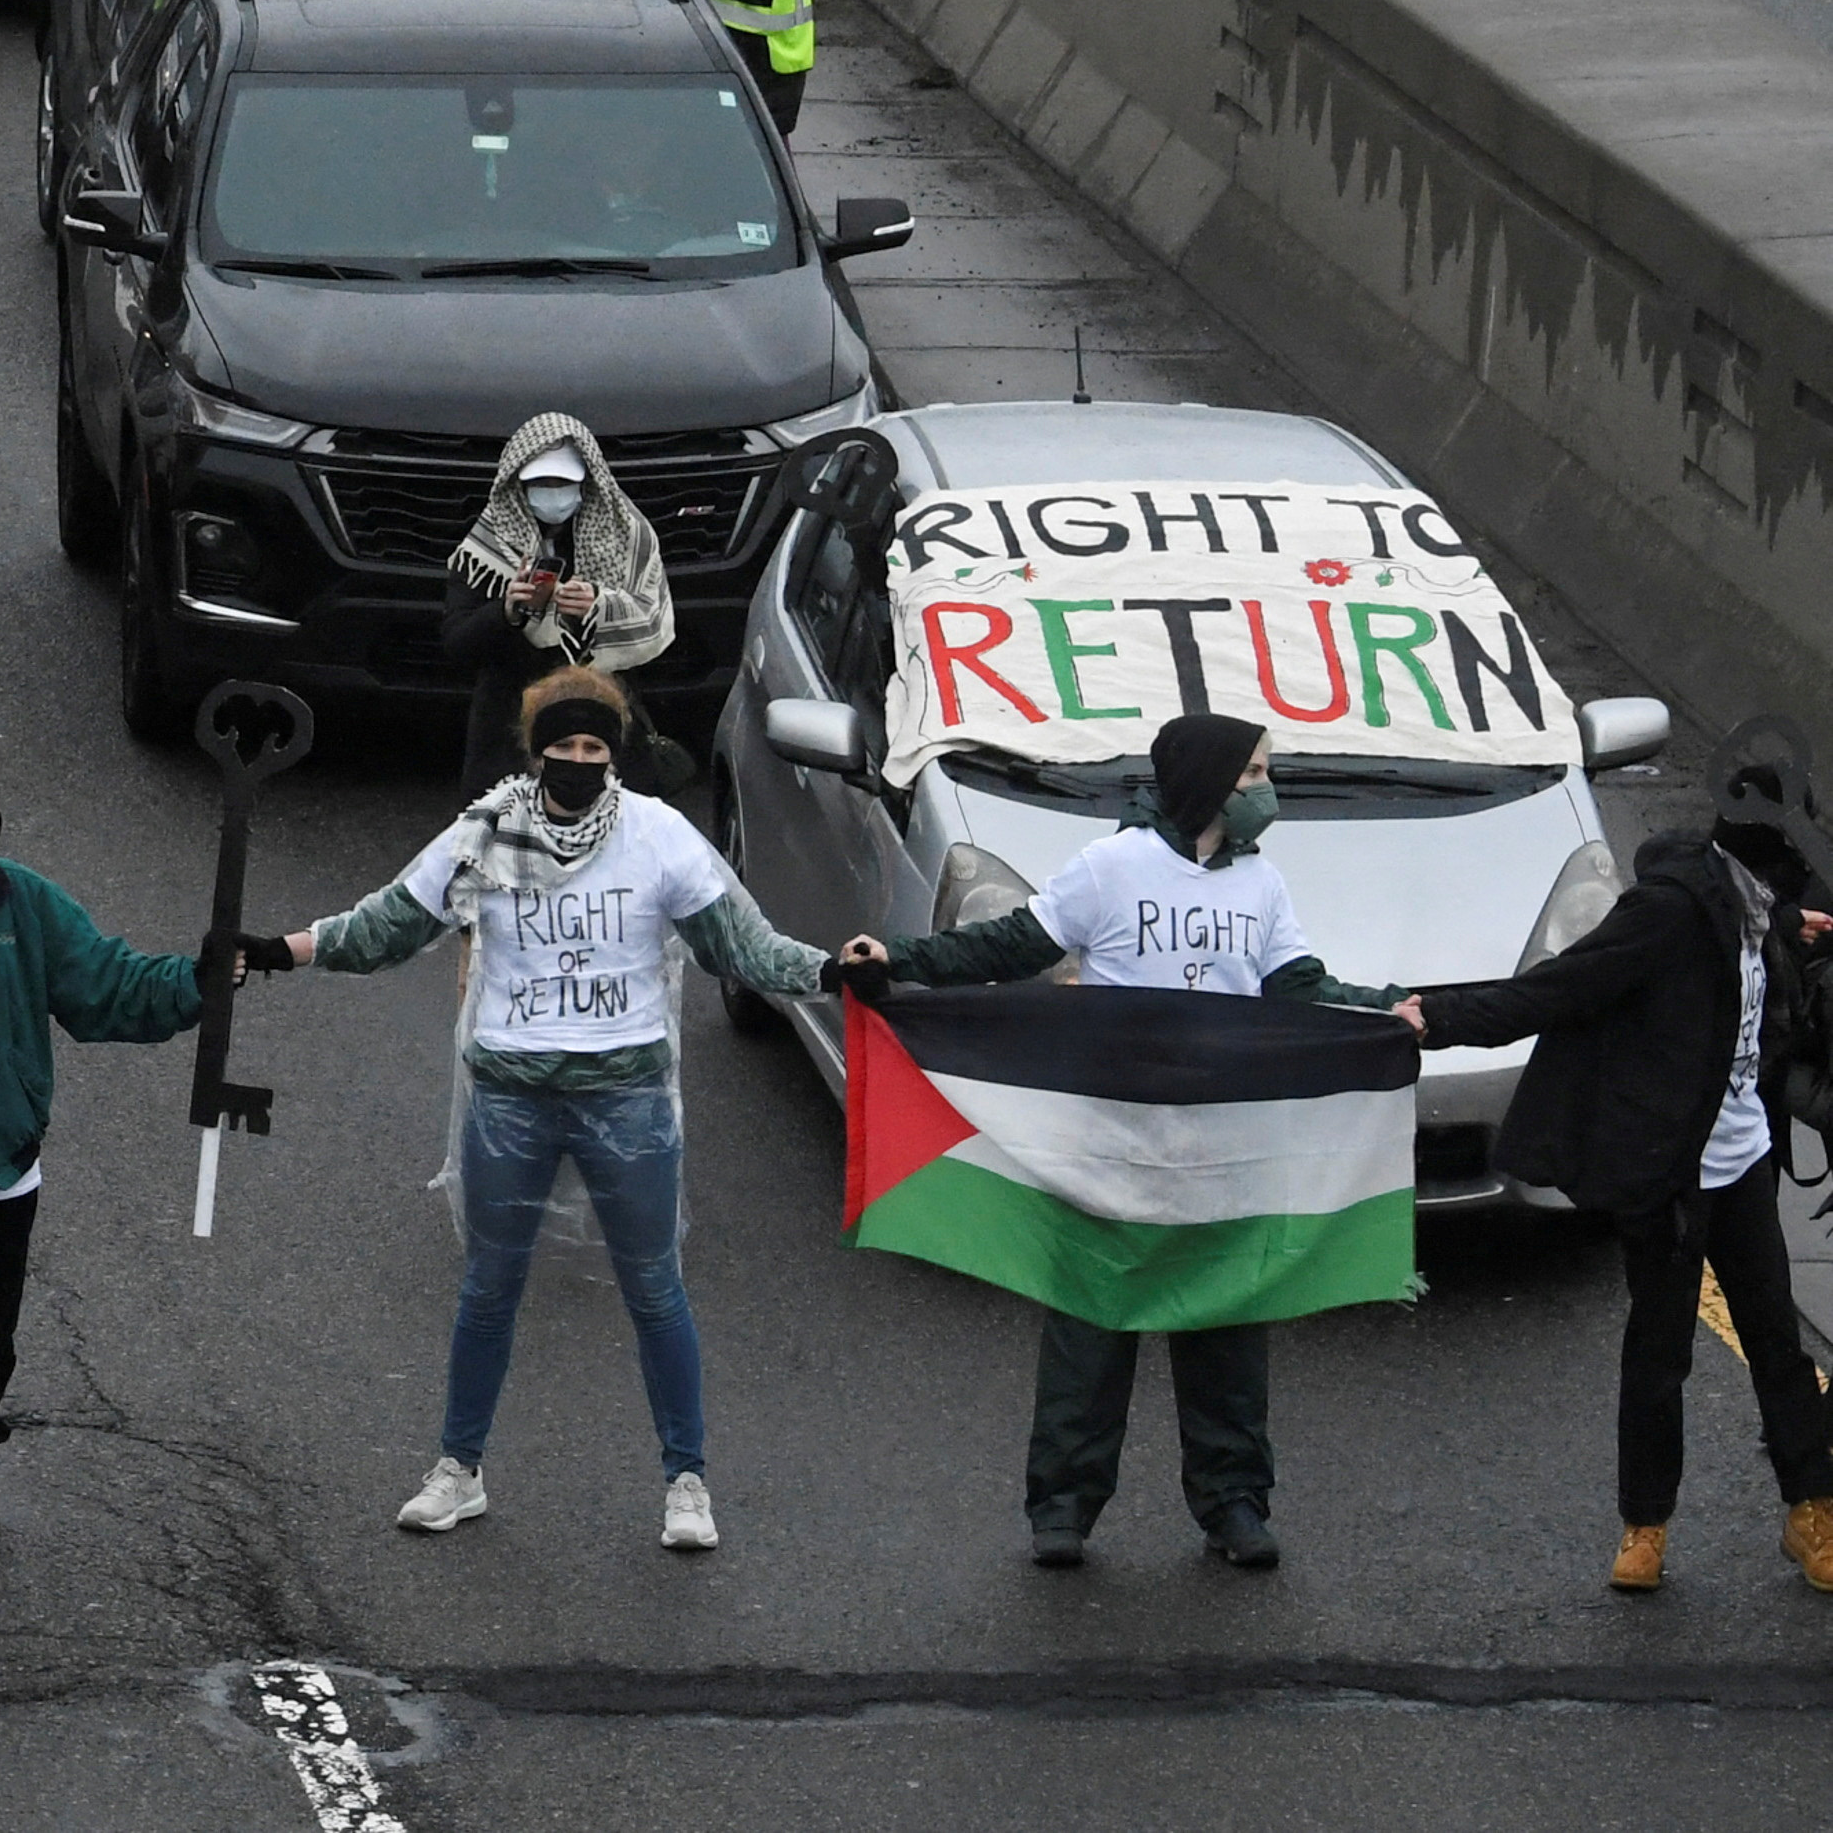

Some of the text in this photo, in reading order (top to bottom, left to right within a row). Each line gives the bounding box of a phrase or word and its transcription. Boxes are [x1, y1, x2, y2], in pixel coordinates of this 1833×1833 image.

[897, 491, 1470, 562] RIGHT TO
[921, 598, 1547, 734] RETURN
[511, 888, 634, 951] RIGHT
[1137, 900, 1258, 956] RIGHT
[558, 947, 595, 973] OF
[506, 974, 628, 1026] RETURN
